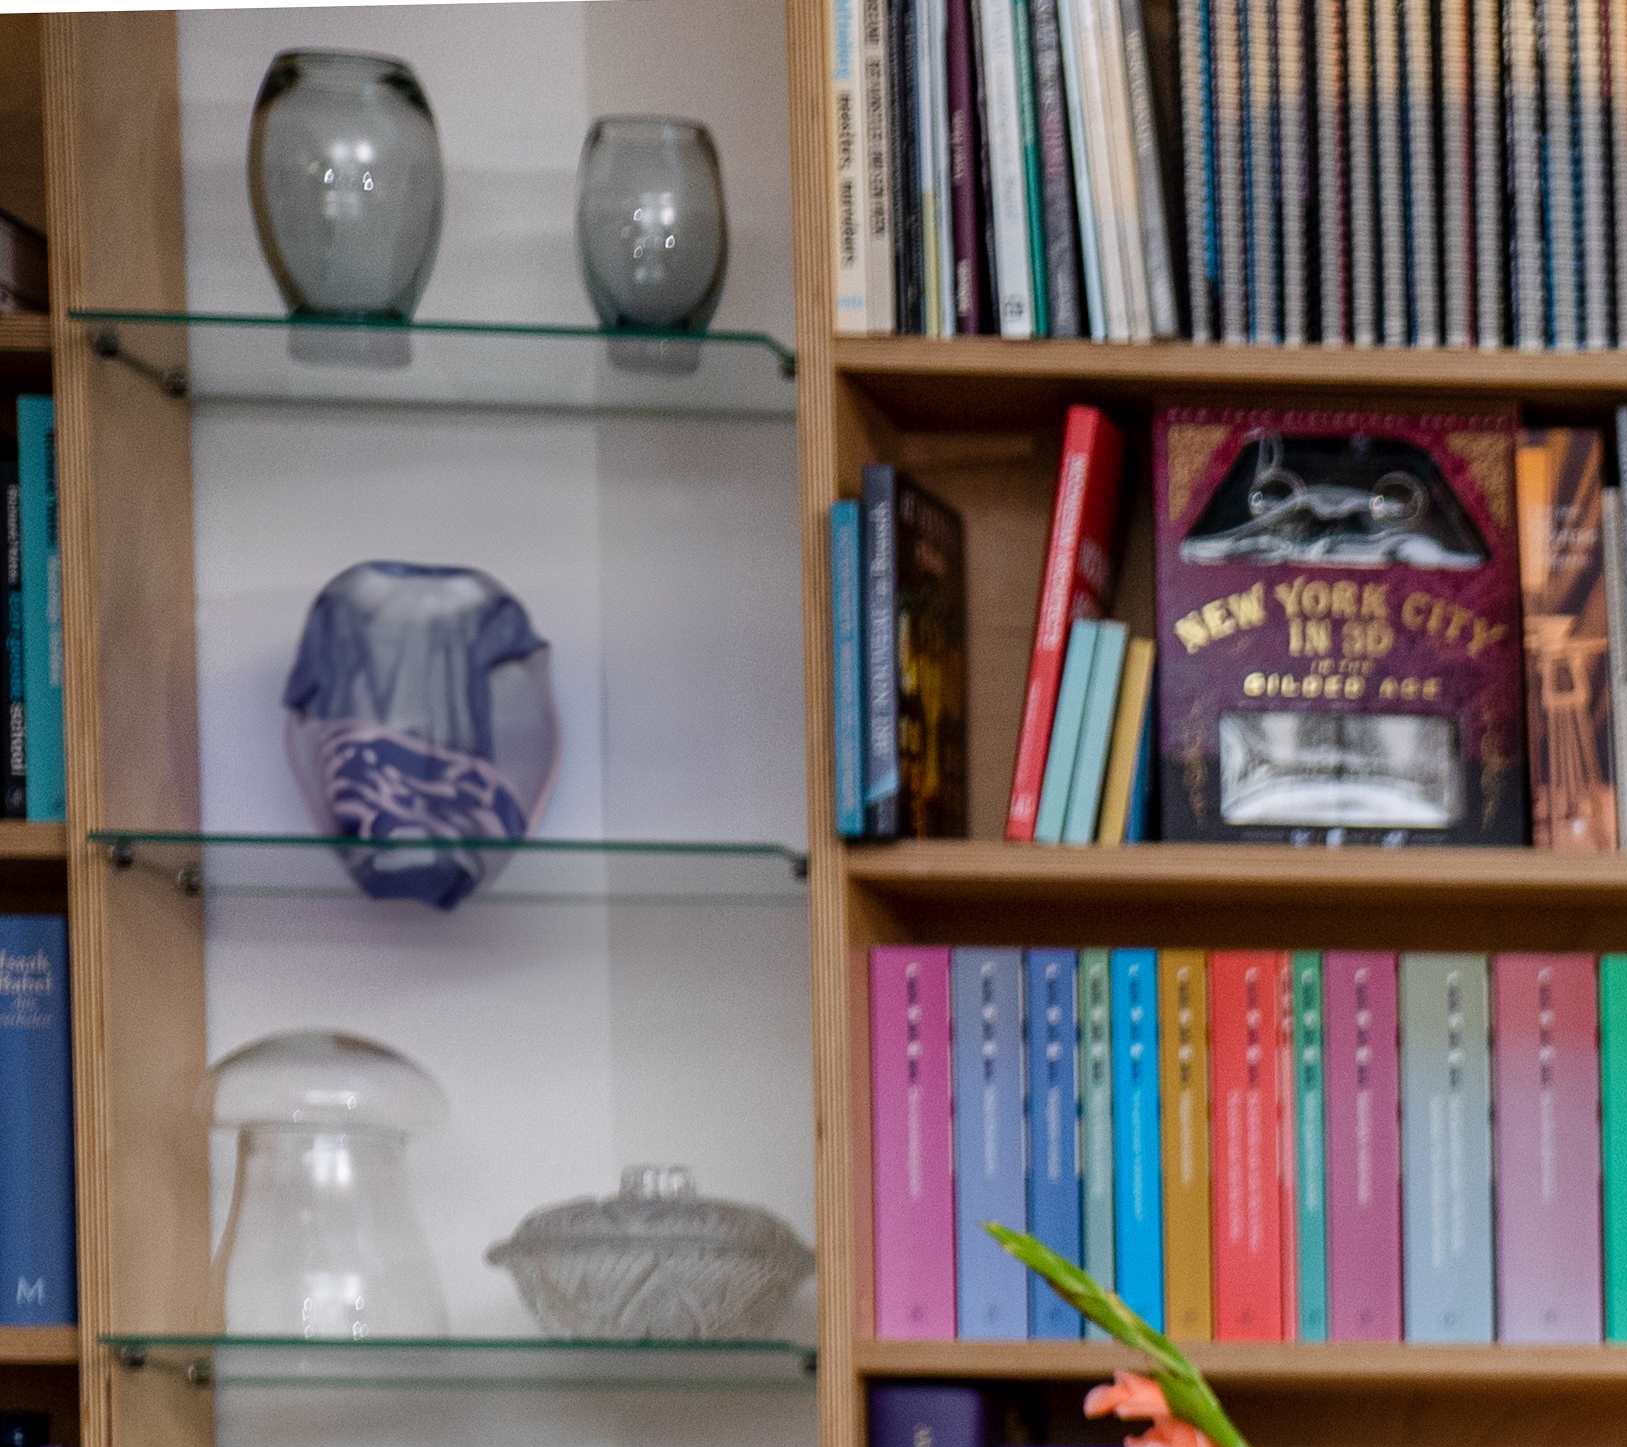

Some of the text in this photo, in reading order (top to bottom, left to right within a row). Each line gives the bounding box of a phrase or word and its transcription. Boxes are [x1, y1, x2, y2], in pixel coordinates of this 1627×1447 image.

[1174, 575, 1509, 659] NEW YORK CITY
[1288, 620, 1333, 657] IN
